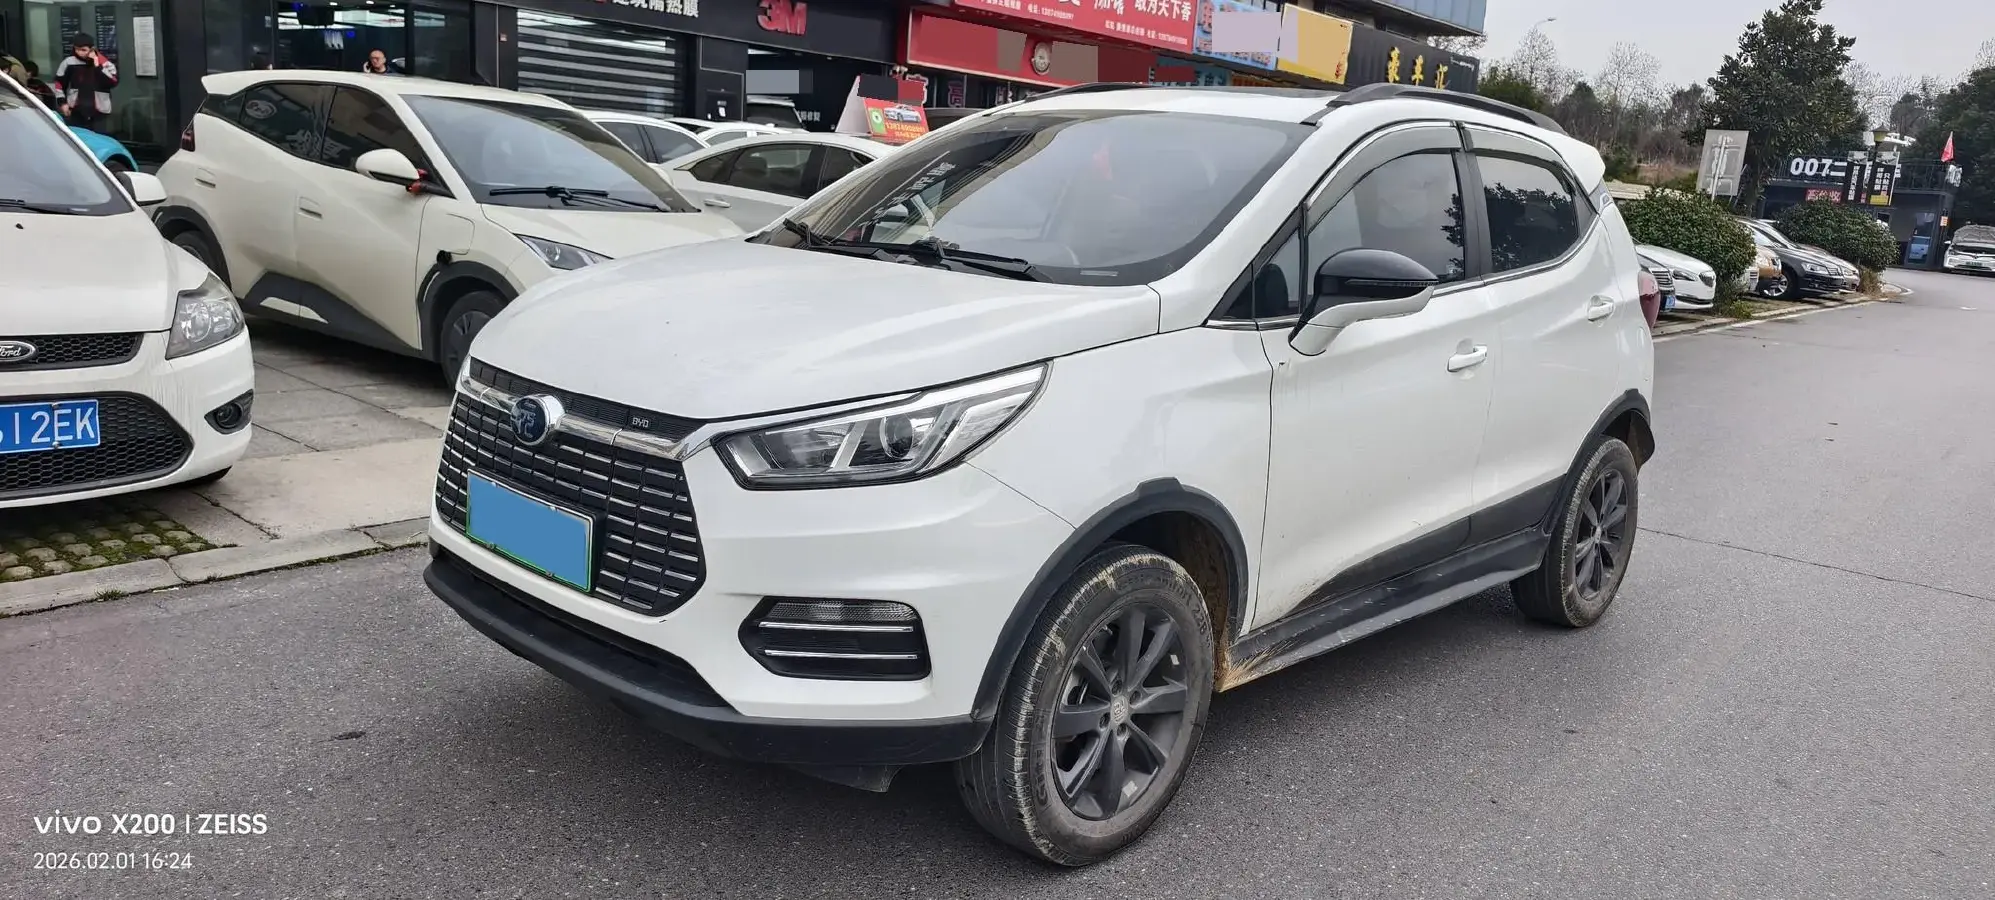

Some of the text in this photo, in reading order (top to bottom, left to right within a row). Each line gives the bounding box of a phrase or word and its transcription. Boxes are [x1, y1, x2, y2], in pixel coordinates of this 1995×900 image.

[757, 0, 807, 35] 3M
[0, 407, 95, 445] 12EK
[631, 417, 650, 429] BYD
